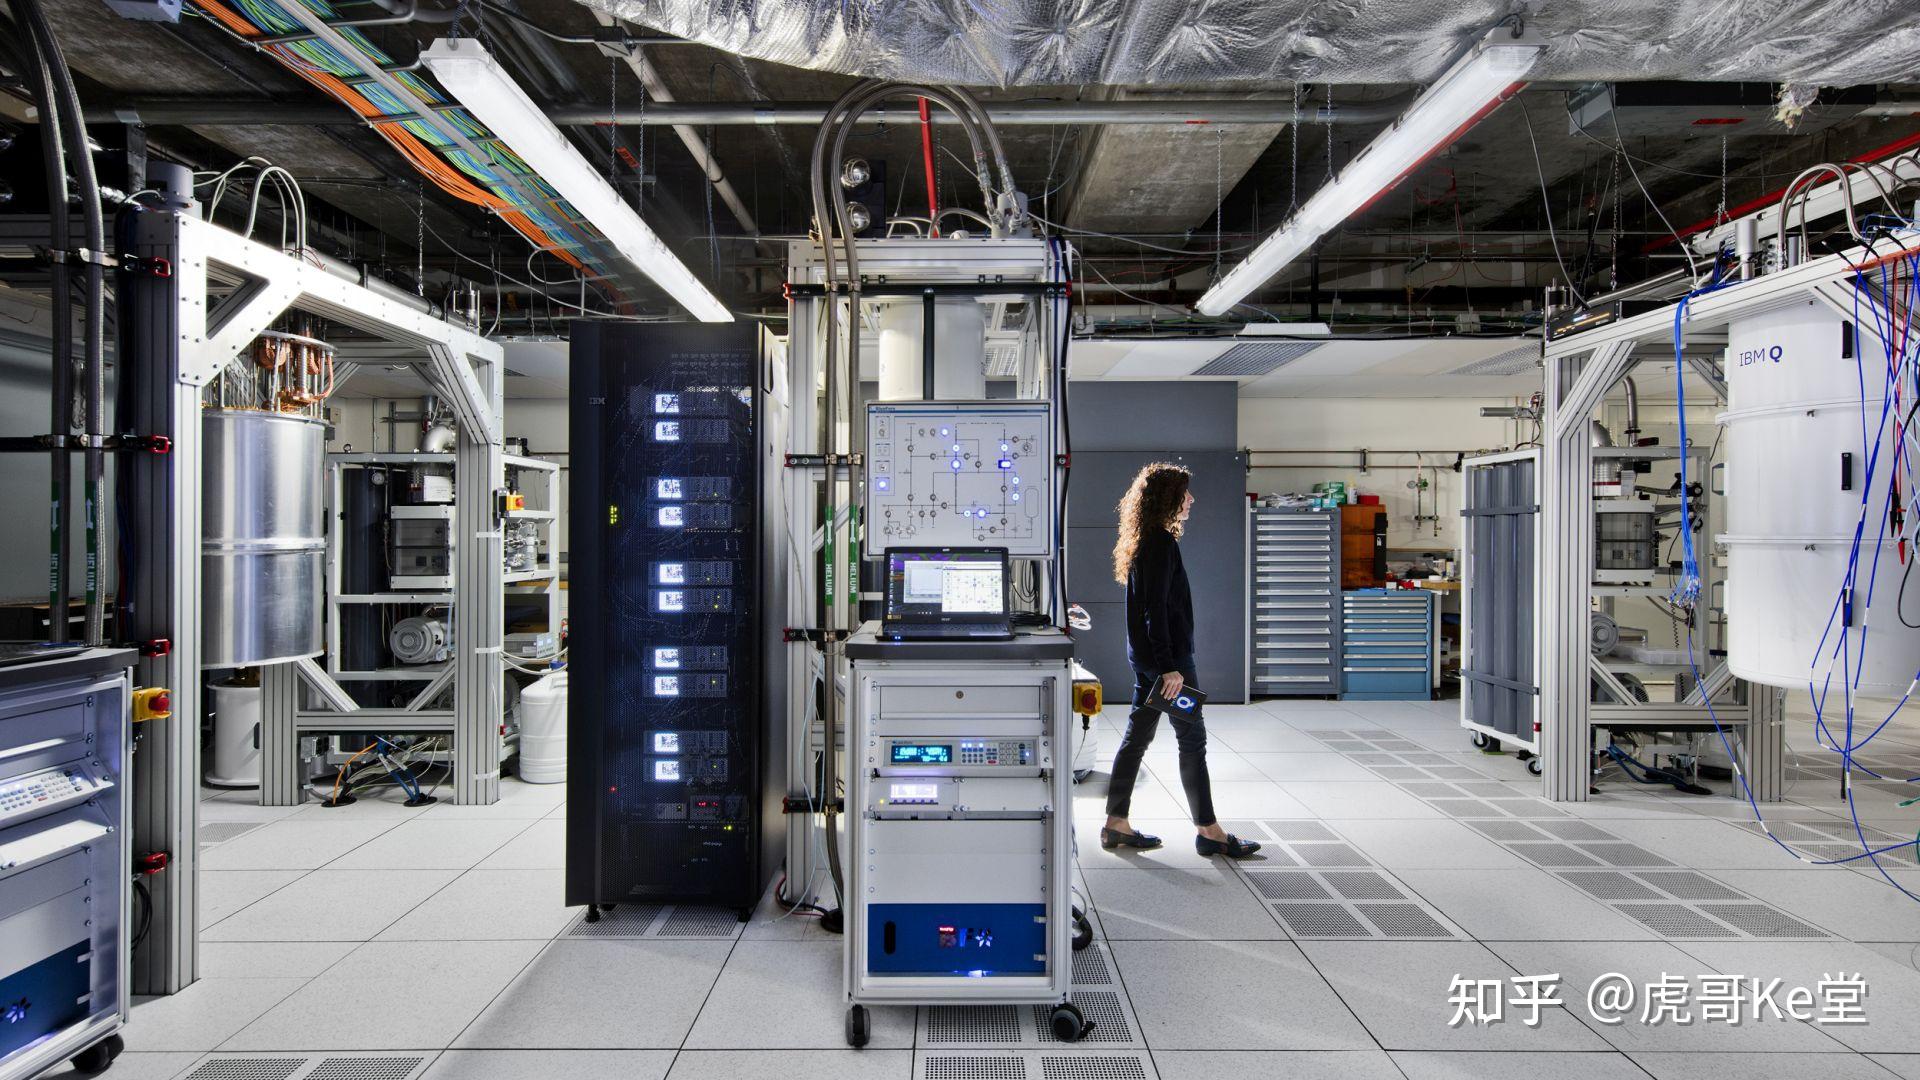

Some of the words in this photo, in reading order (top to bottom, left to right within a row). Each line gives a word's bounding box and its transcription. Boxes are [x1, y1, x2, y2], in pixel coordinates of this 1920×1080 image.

[1740, 348, 1765, 366] IBM
[1769, 345, 1783, 363] Q
[589, 397, 605, 405] IBM
[49, 553, 59, 592] HELIUM
[86, 553, 95, 591] HELIUM
[825, 563, 833, 596] HELIUM
[849, 562, 857, 594] HELIUM
